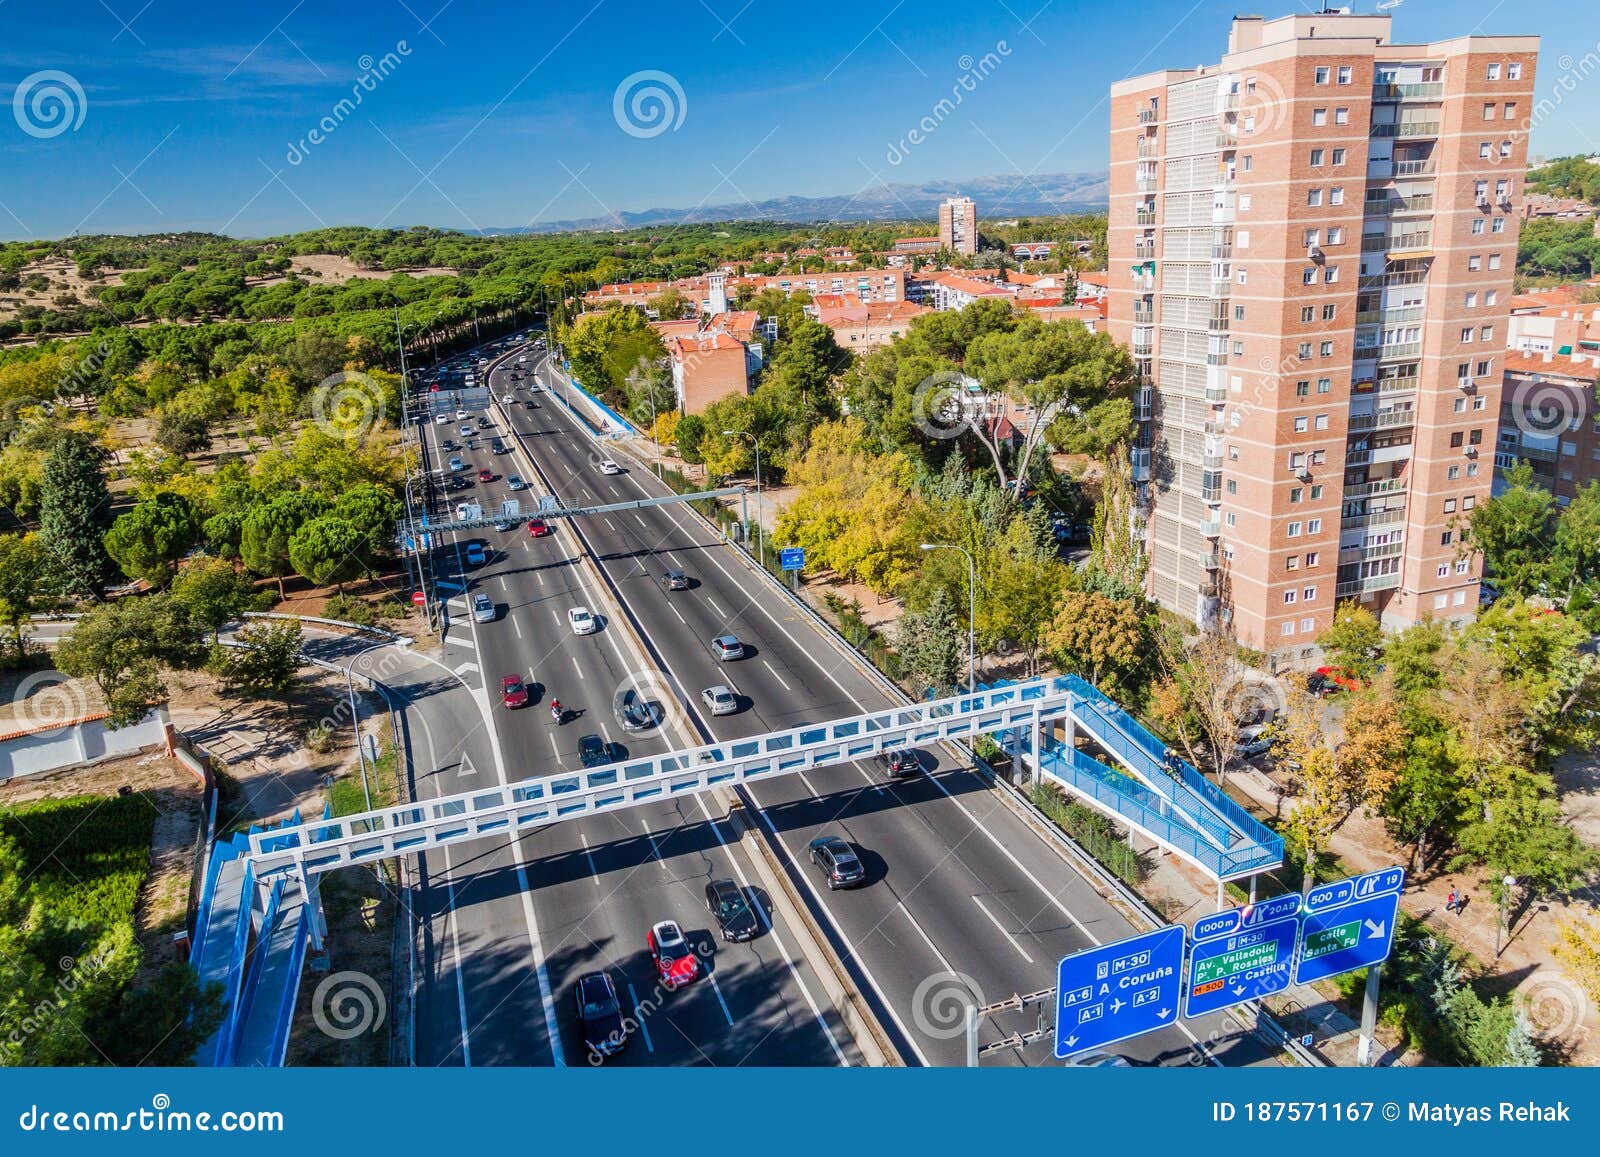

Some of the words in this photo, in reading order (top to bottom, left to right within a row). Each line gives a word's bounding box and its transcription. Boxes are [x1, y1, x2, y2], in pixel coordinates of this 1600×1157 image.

[1386, 874, 1398, 885] 19
[1311, 892, 1332, 905] 500
[1338, 890, 1347, 898] m
[1240, 933, 1263, 945] M-30
[1306, 943, 1338, 958] Santa
[1344, 937, 1356, 947] Fe
[1115, 953, 1148, 972] M-30
[1198, 961, 1216, 972] Av.
[1222, 942, 1276, 964] Valladolid
[1232, 955, 1274, 972] Rosales
[1245, 963, 1286, 980] Castilla
[1099, 982, 1110, 996] A
[1119, 966, 1173, 989] Coruña
[1195, 980, 1224, 993] M-500
[1067, 989, 1090, 1004] A-6
[1136, 990, 1157, 1005] A-2
[1081, 1006, 1102, 1021] A-1
